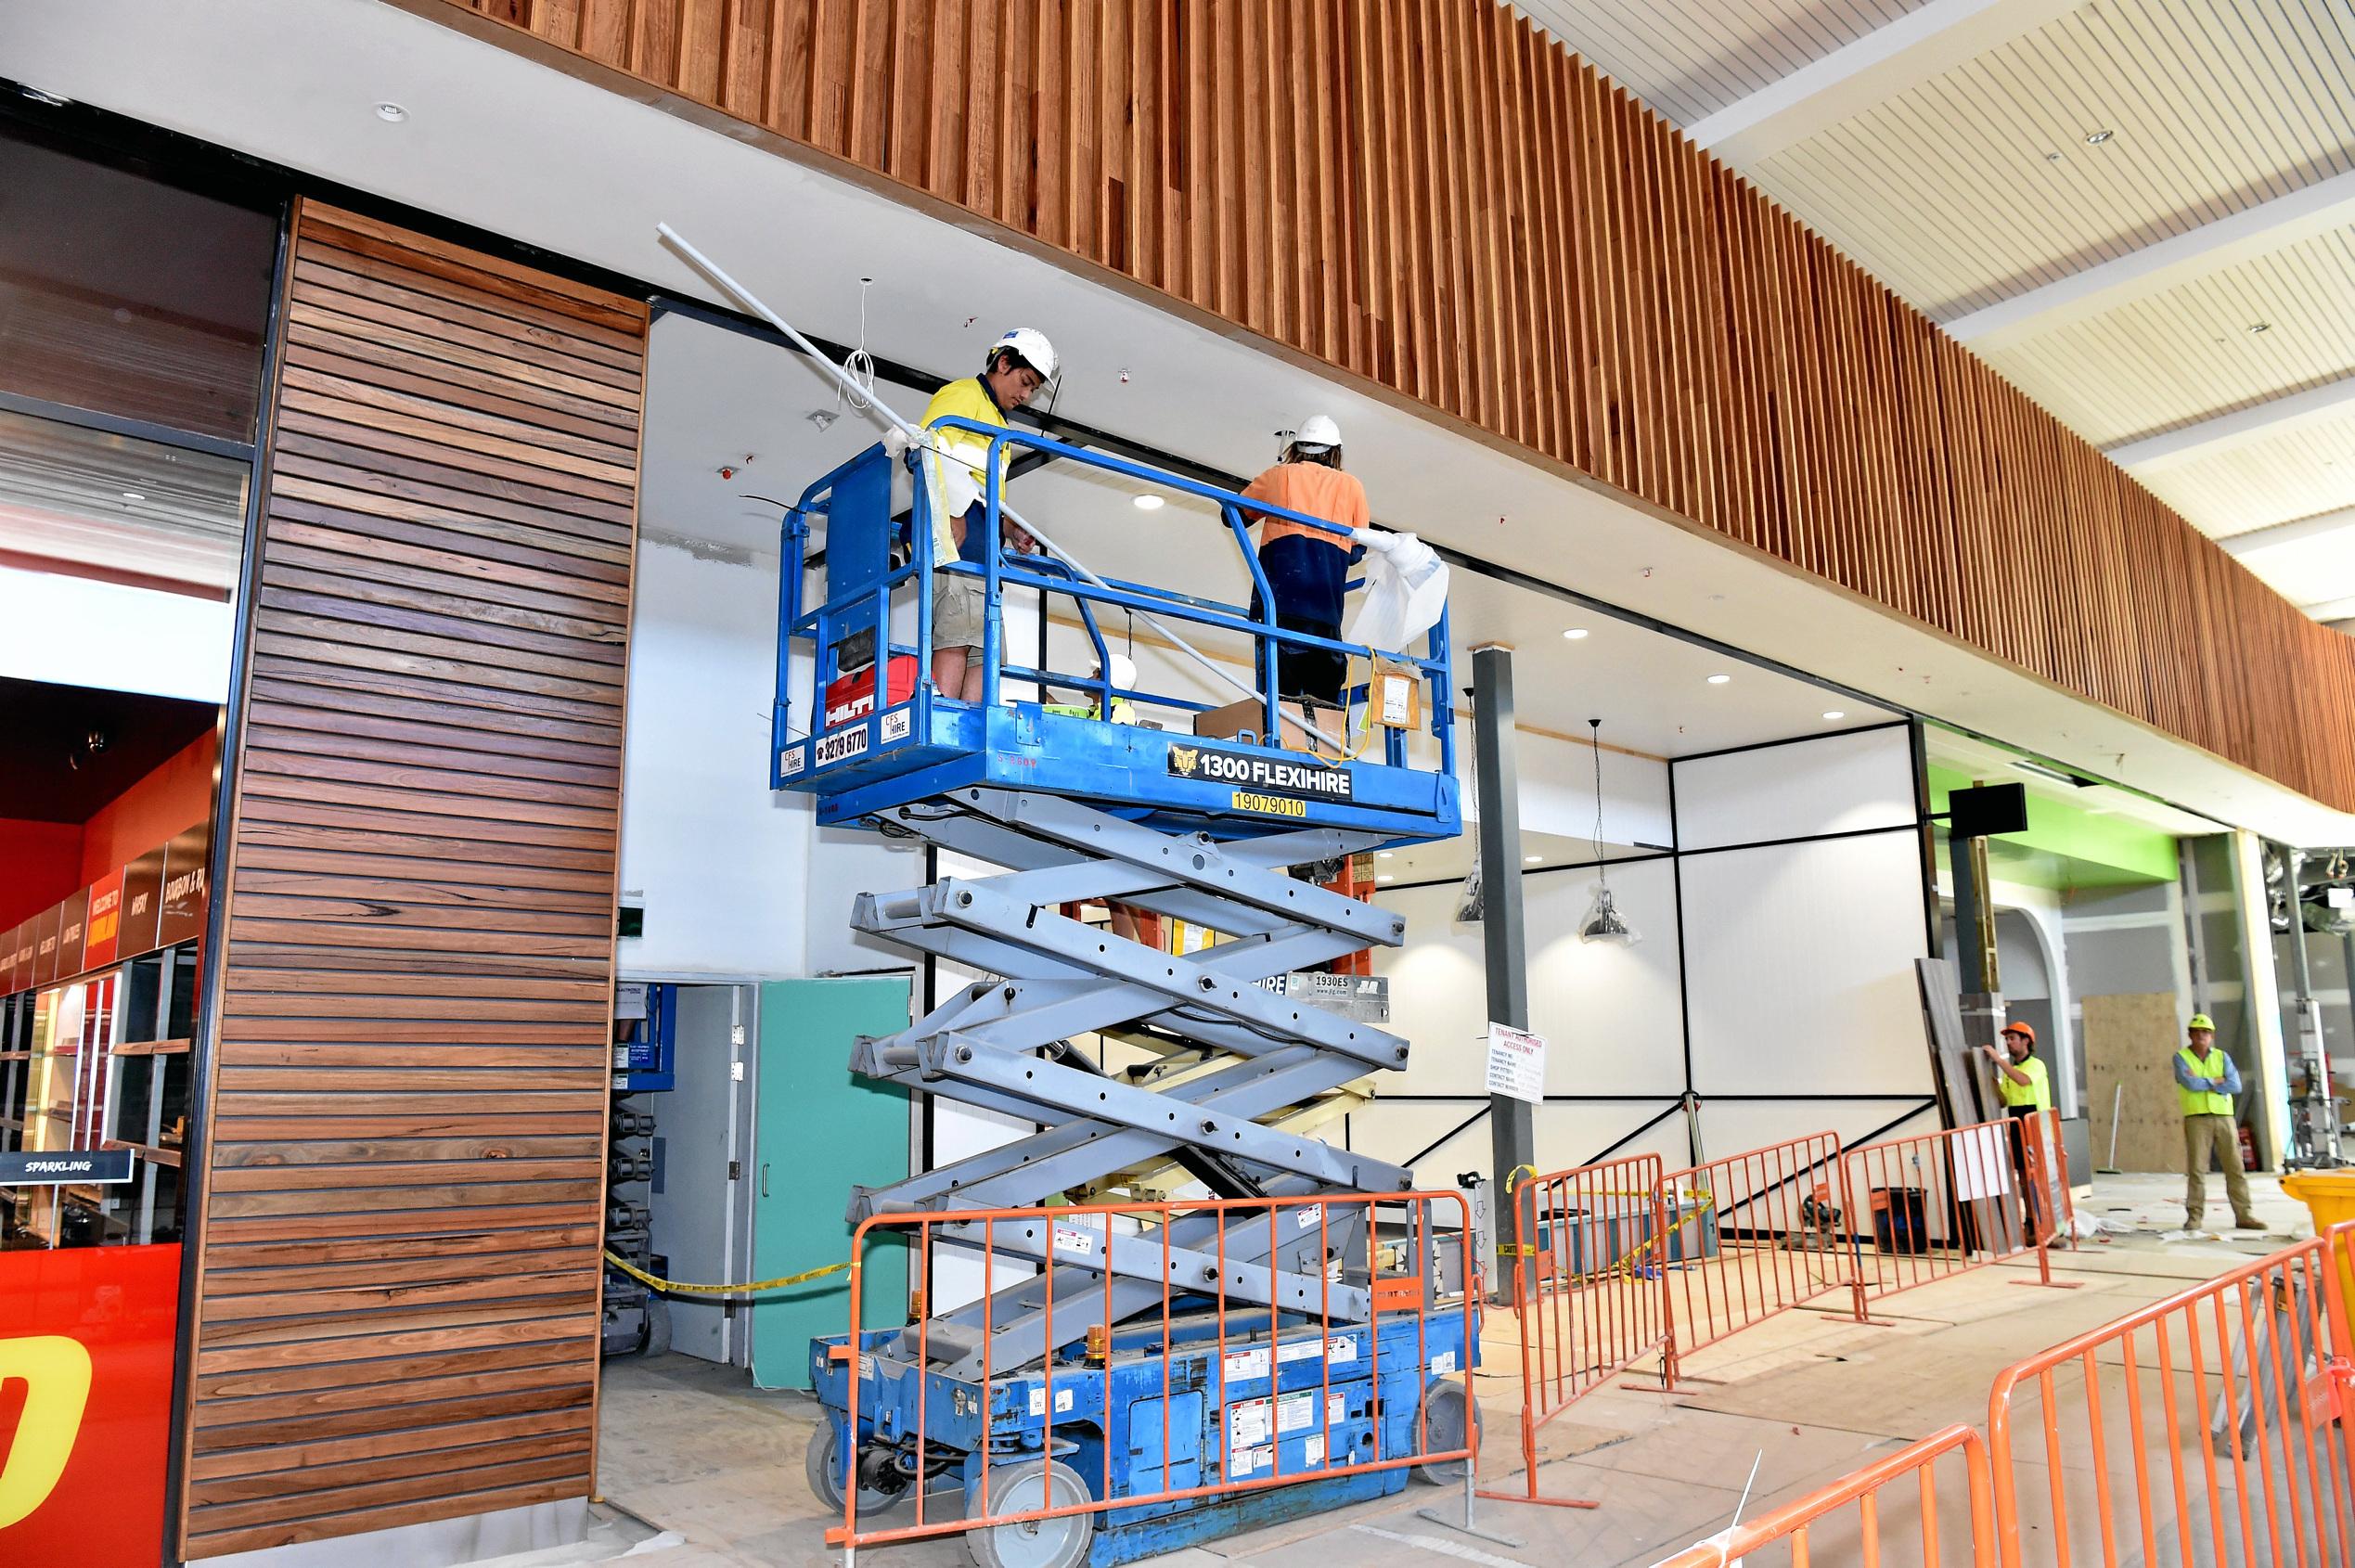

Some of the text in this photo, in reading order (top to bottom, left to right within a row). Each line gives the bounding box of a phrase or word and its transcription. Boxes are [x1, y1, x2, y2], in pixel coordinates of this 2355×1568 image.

[825, 694, 874, 727] HILTI
[825, 736, 844, 761] 3279
[846, 728, 867, 753] 6770
[788, 757, 802, 770] HIRE
[1200, 753, 1350, 794] 1300 FLEXIHIRE
[1235, 792, 1304, 816] 19079010
[1316, 976, 1348, 987] 1930ES
[1503, 1040, 1522, 1051] ACCESS
[25, 1161, 93, 1173] SPARKLING
